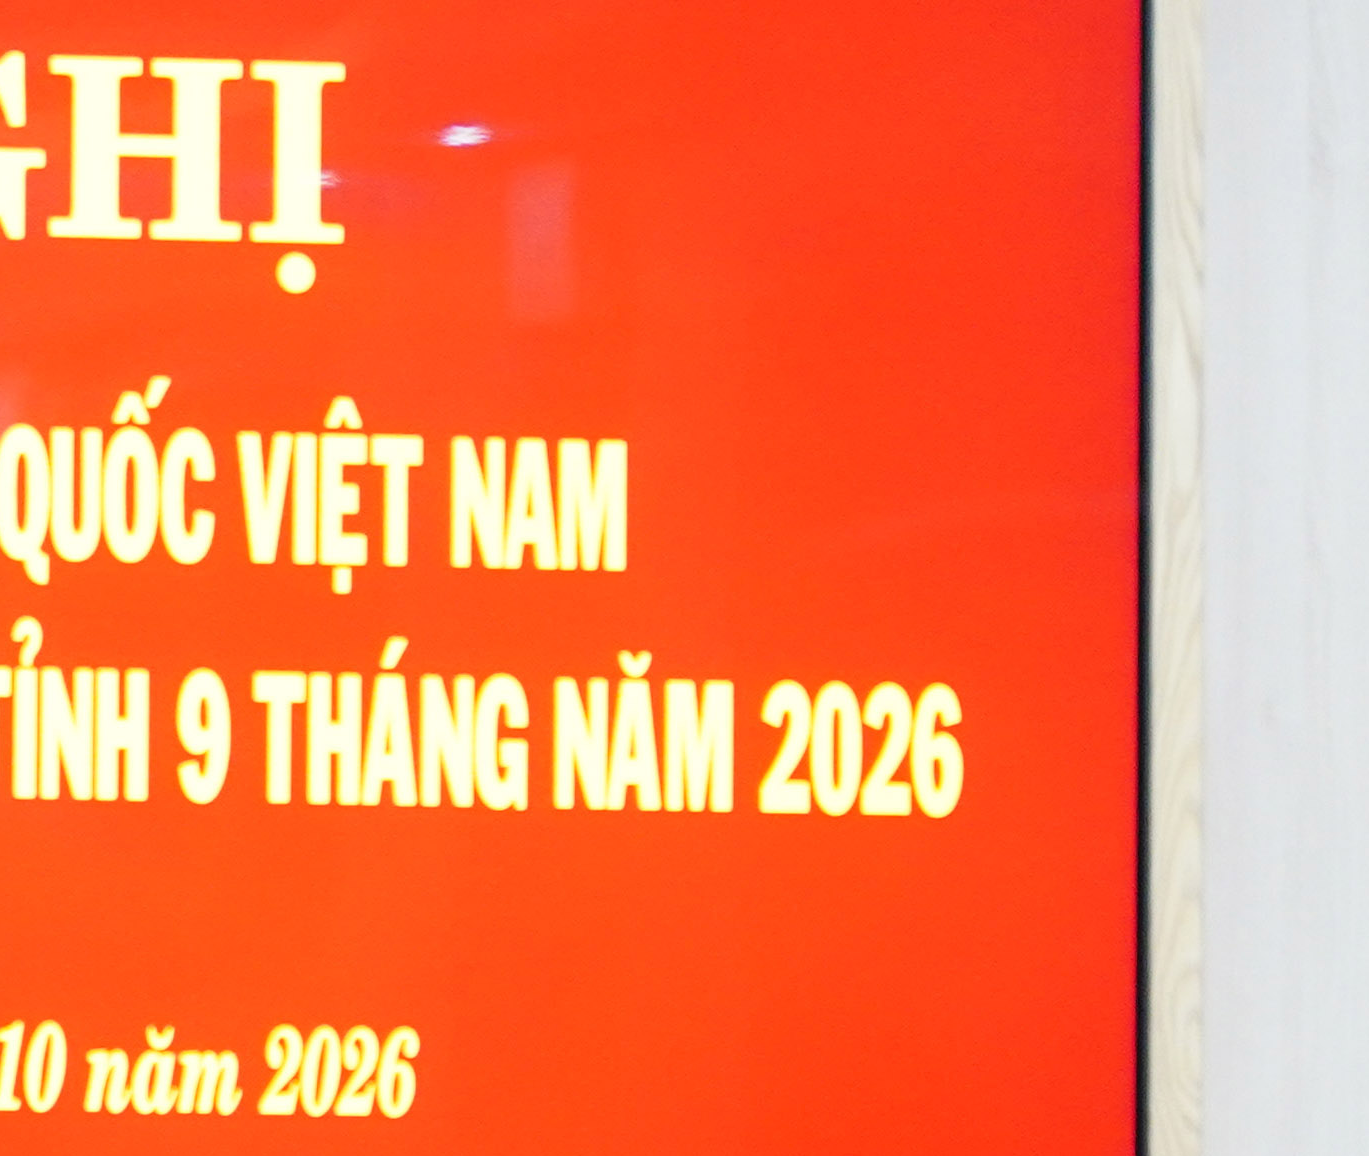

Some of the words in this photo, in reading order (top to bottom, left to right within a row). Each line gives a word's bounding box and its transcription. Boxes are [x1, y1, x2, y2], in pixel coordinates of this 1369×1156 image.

[235, 395, 425, 595] VIỆT
[450, 435, 629, 572] NAM
[175, 666, 232, 806] 9
[251, 635, 531, 812] THÁNG
[552, 650, 736, 813] NĂM
[757, 678, 965, 819] 2026
[82, 1023, 244, 1117] năm
[257, 1022, 422, 1120] 2026
